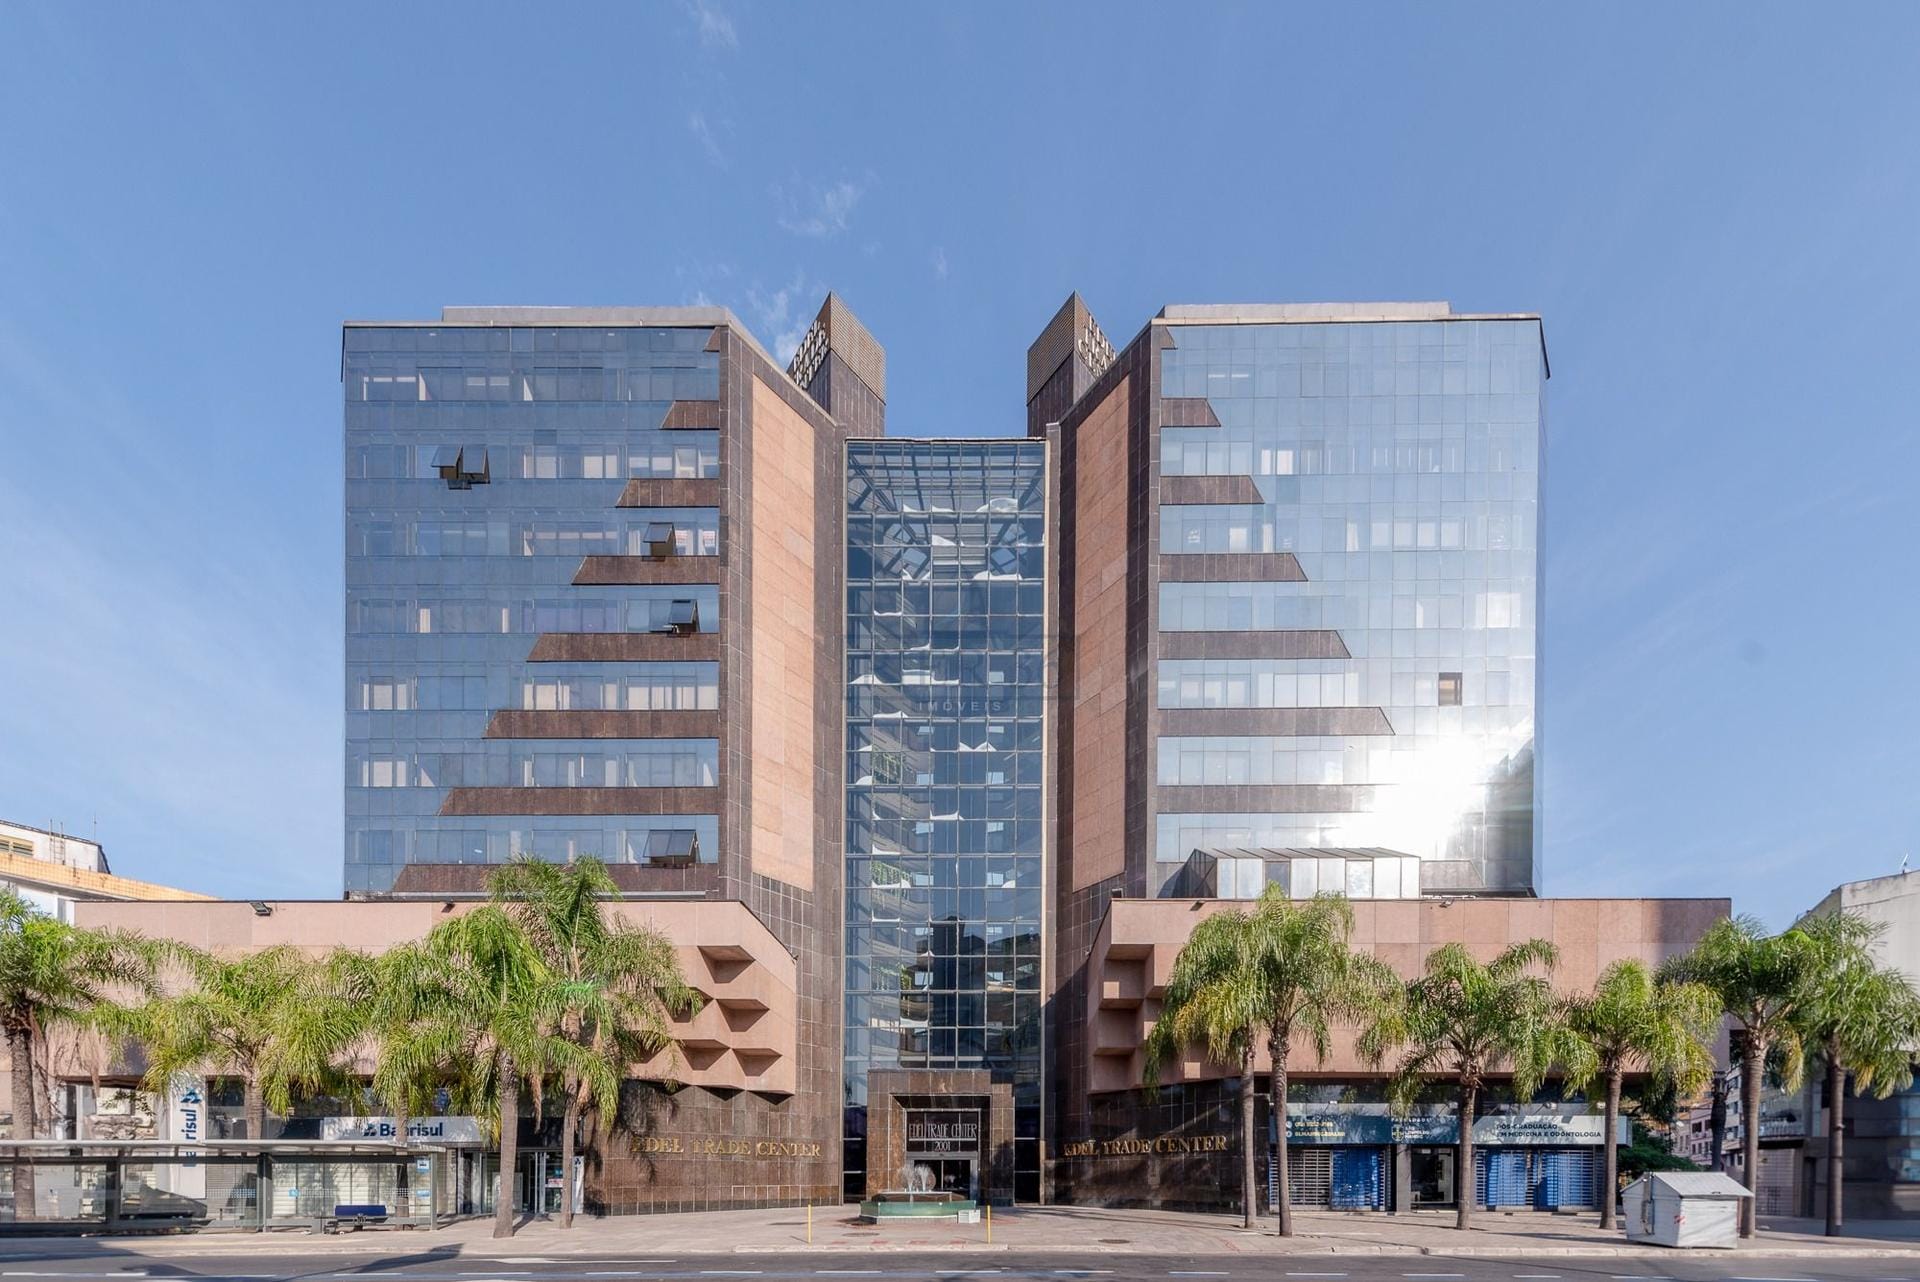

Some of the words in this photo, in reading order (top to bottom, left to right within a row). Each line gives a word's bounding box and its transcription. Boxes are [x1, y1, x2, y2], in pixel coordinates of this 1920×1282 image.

[909, 1123, 924, 1138] EDEL
[927, 1123, 949, 1138] TRADE
[951, 1123, 977, 1138] CENTER
[1496, 1121, 1558, 1131] PÓS-GRADUAÇÃO
[180, 1109, 197, 1167] arisul
[934, 1141, 952, 1152] 2001
[1063, 1140, 1098, 1156] EDEL
[1102, 1138, 1151, 1155] TRADE
[1155, 1135, 1227, 1153] CENTER
[631, 1137, 684, 1153] EDEL
[691, 1138, 751, 1155] TRADE
[756, 1141, 822, 1158] CENTER
